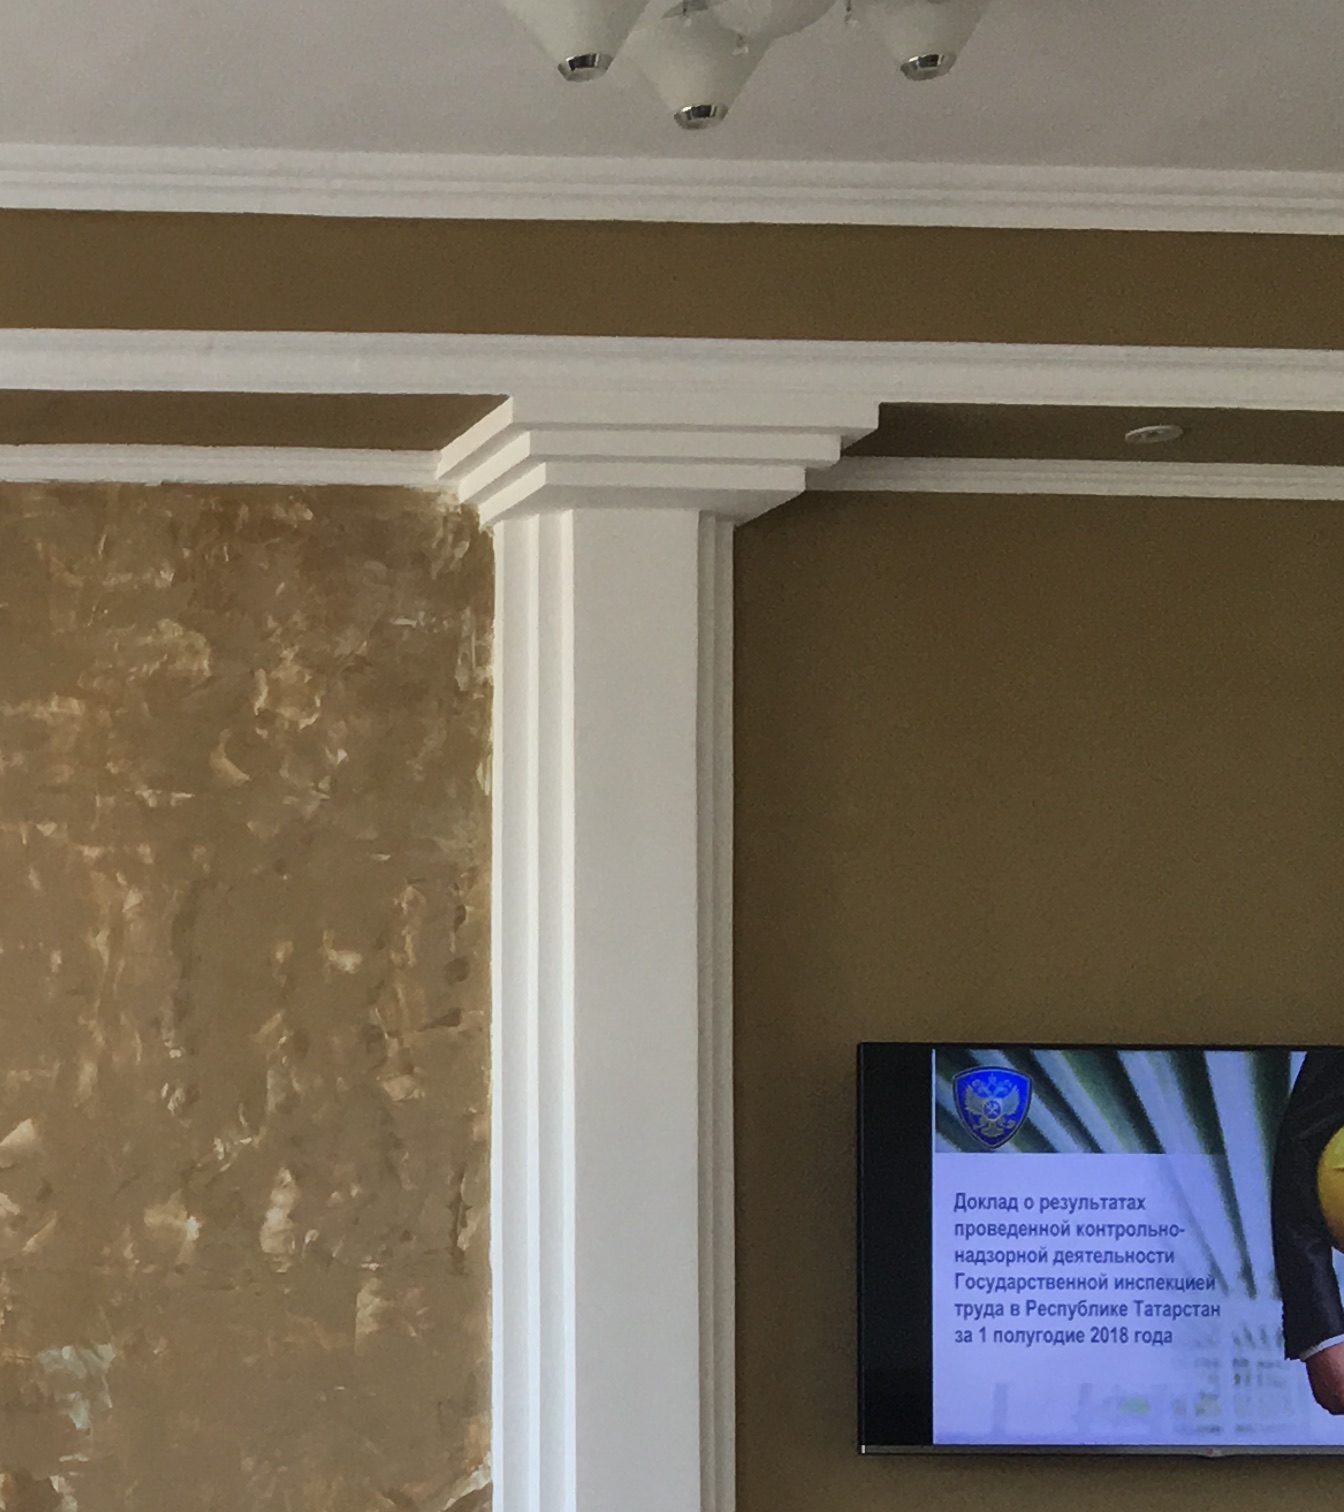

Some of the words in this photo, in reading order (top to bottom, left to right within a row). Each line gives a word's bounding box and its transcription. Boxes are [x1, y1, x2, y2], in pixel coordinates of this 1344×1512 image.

[953, 1193, 1018, 1213] Доклад
[1024, 1196, 1034, 1210] о
[1039, 1195, 1146, 1214] результатах
[954, 1220, 1071, 1240] проведенной
[1076, 1223, 1185, 1241] контрольно-
[955, 1247, 1048, 1267] надзорной
[1053, 1250, 1174, 1266] деятельности
[955, 1272, 1108, 1293] Государственной
[1114, 1274, 1216, 1293] инспекцией
[954, 1303, 1004, 1320] труда
[1011, 1303, 1020, 1316] в
[1025, 1299, 1128, 1321] Республике
[1133, 1299, 1220, 1321] Татарстан
[955, 1330, 972, 1343] за
[979, 1327, 986, 1343] 1
[993, 1329, 1085, 1347] полугодие
[1090, 1327, 1129, 1343] 2018
[1134, 1330, 1172, 1346] года
